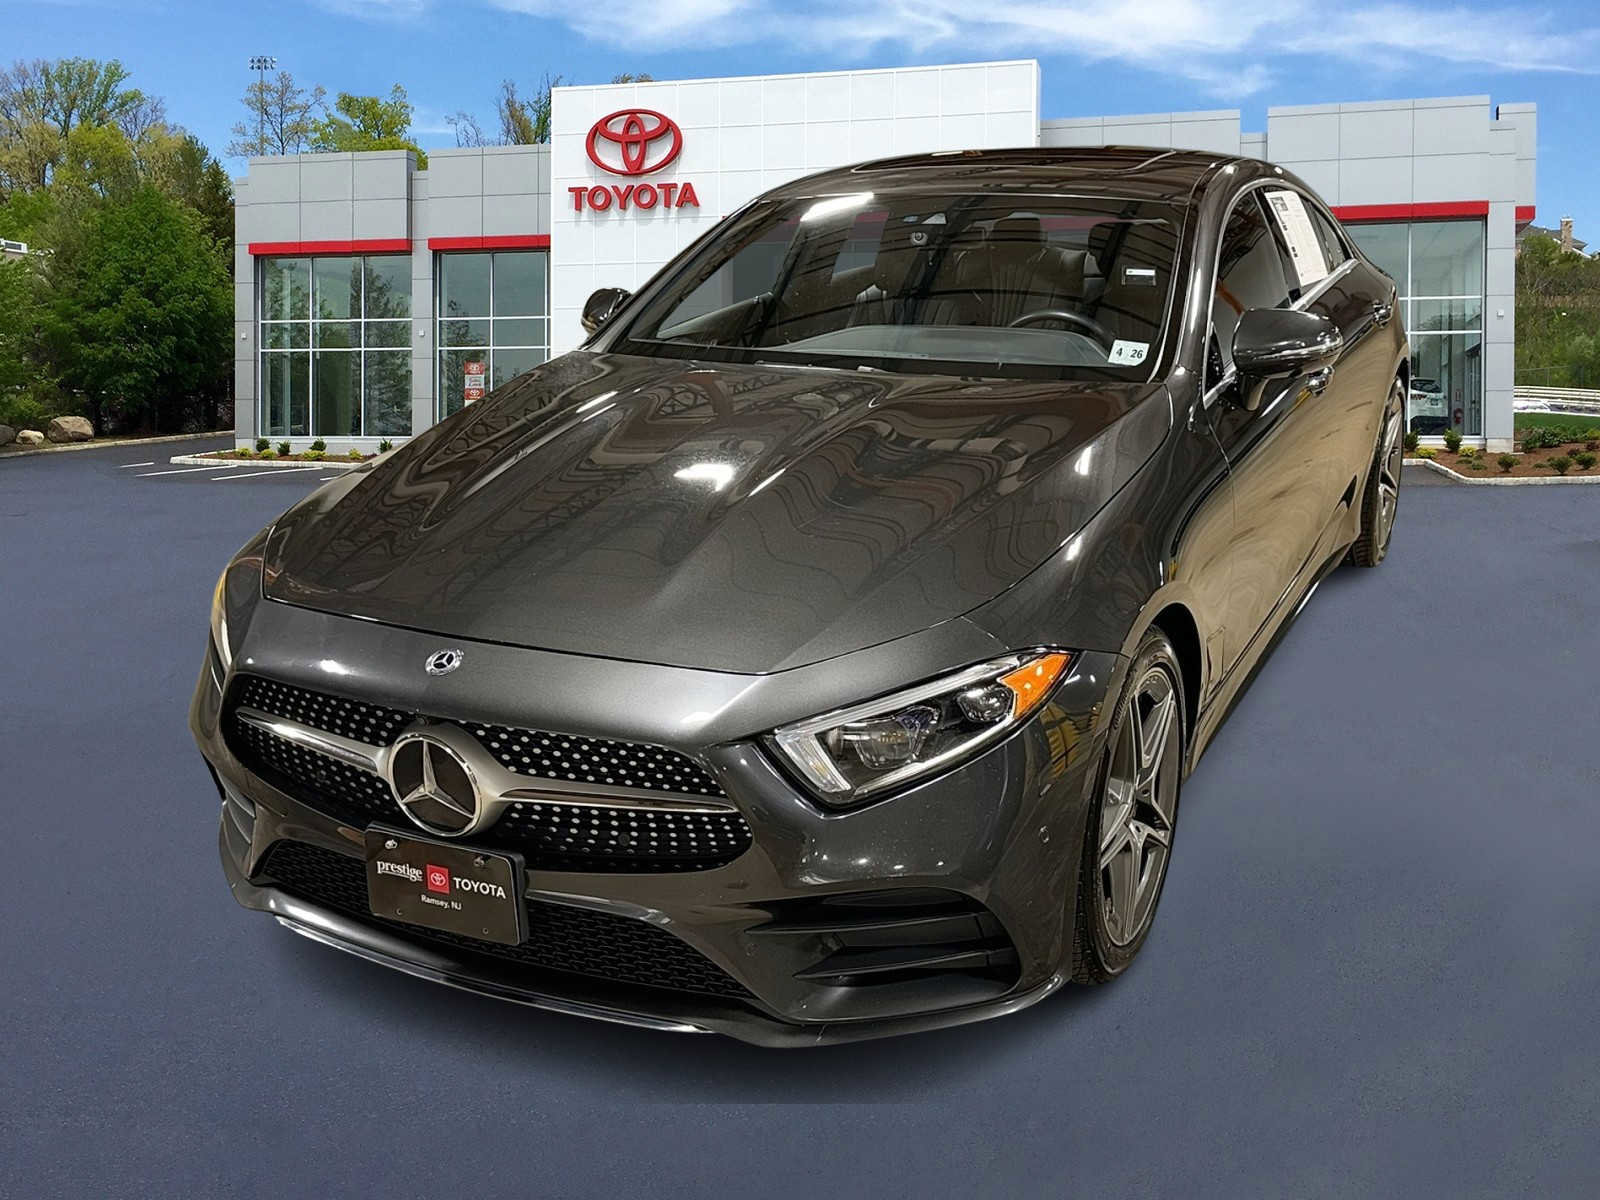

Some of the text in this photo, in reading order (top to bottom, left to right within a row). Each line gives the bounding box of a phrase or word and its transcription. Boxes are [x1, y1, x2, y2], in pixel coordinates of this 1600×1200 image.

[568, 182, 700, 211] TOYOTA
[1116, 348, 1143, 359] 4 26
[376, 860, 507, 899] prestige TOYOTA
[421, 894, 462, 911] Ramsey, NJ
